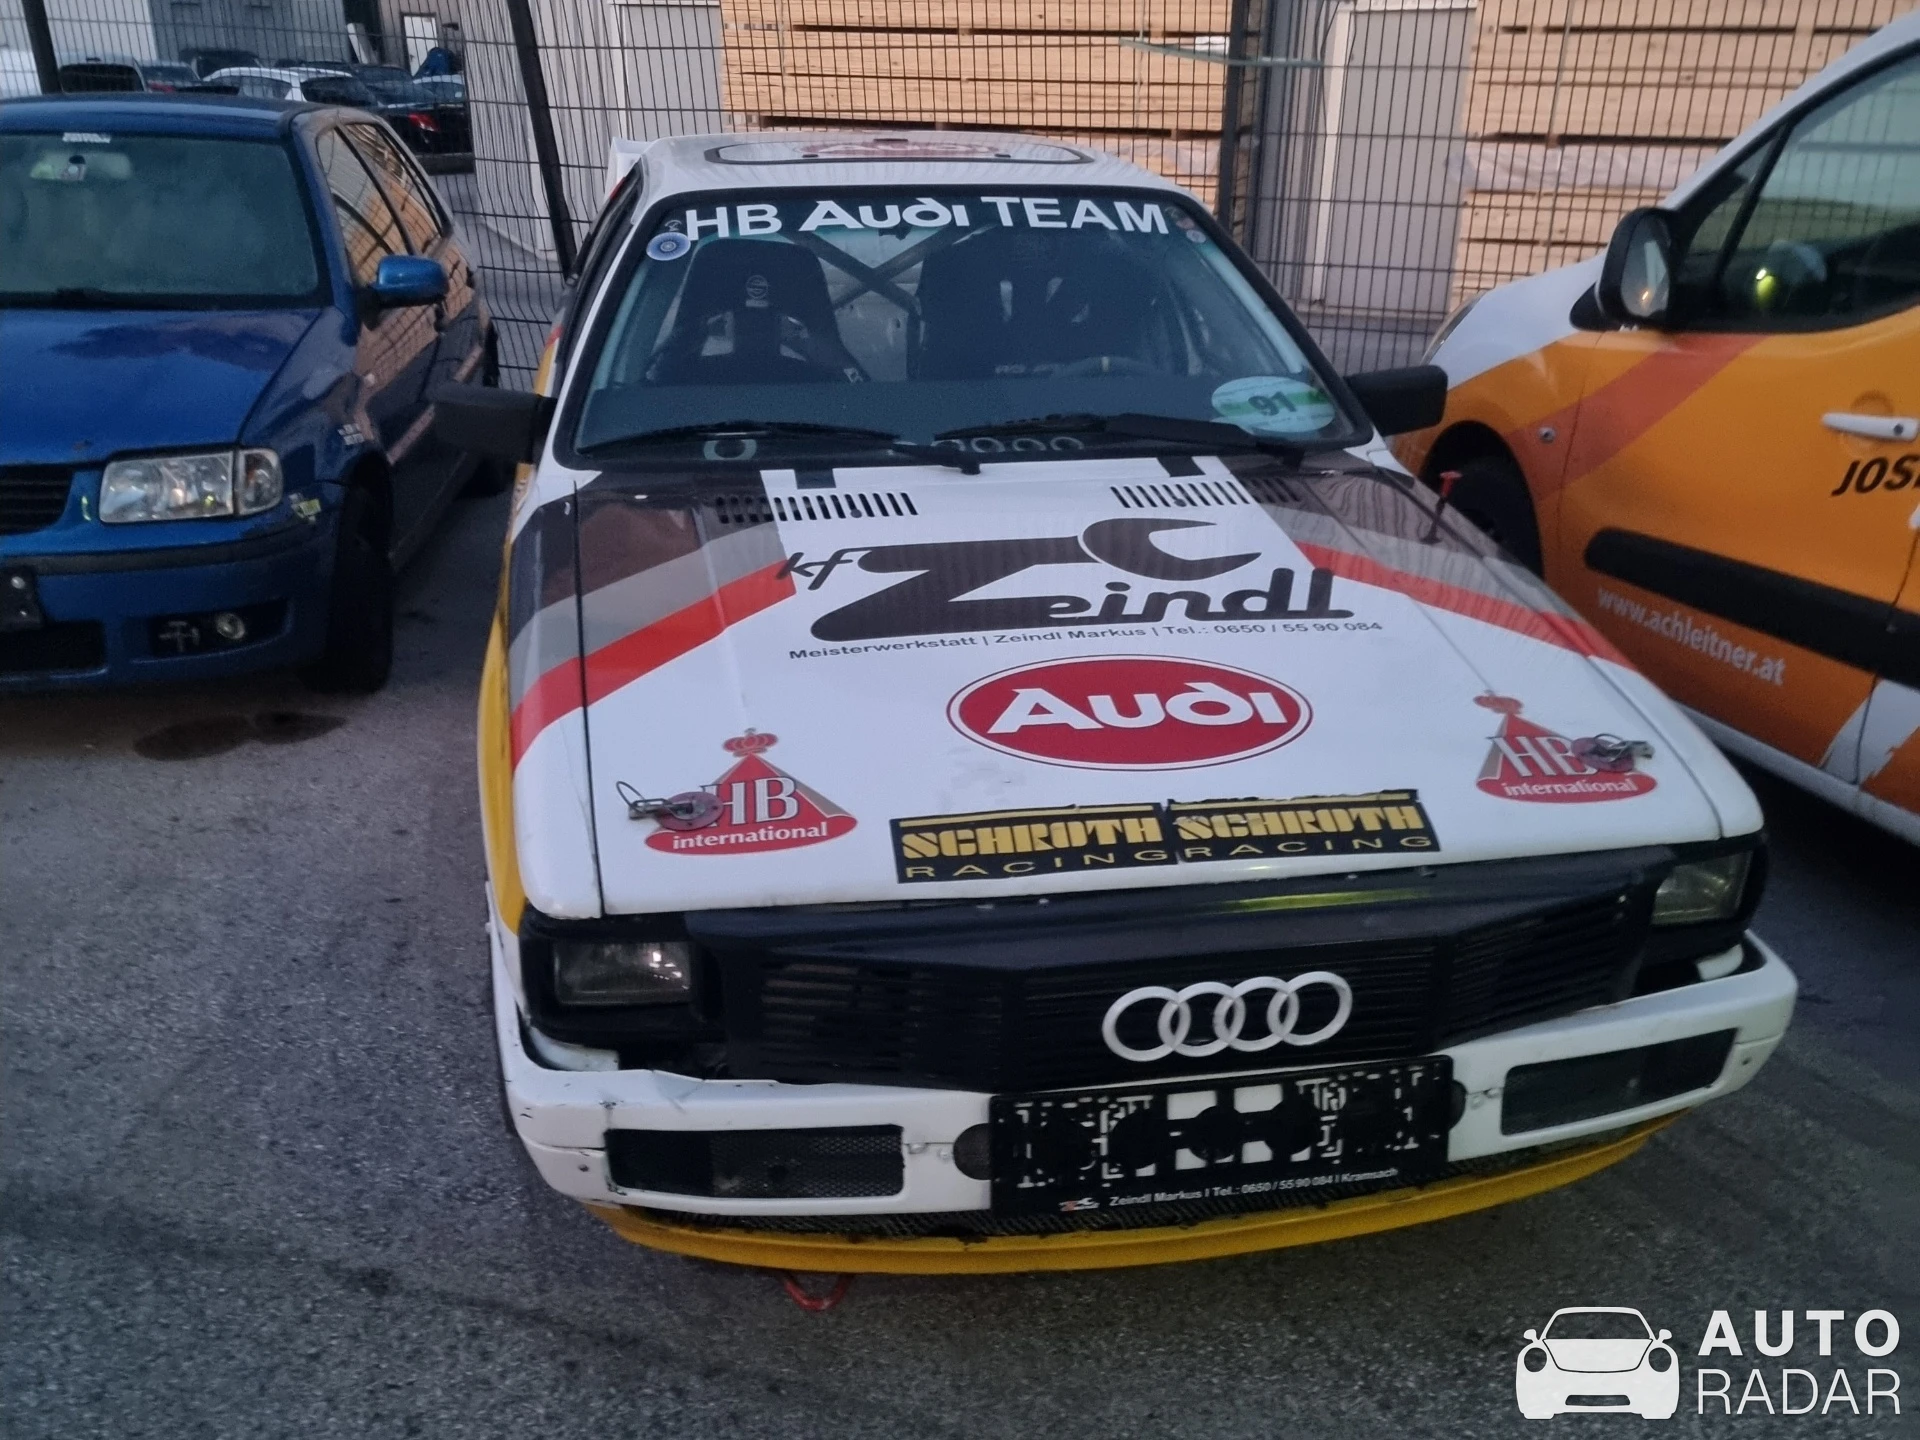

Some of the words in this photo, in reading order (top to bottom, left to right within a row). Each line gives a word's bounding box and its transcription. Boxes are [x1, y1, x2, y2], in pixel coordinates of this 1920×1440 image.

[686, 204, 782, 241] HB
[799, 198, 969, 231] Audi
[981, 197, 1169, 234] TEAM
[1831, 453, 1920, 497] JOS
[789, 636, 978, 659] Meisterwerkstatt
[995, 631, 1063, 645] Zeindl
[1069, 627, 1147, 640] Markus
[1166, 625, 1207, 635] Tel.:
[1214, 624, 1266, 634] 0650
[1281, 622, 1309, 633] 55
[1314, 622, 1341, 632] 90
[1346, 621, 1384, 632] 084
[1597, 588, 1786, 686] www.achleitner.at
[987, 682, 1287, 734] Audi
[1501, 778, 1639, 797] international
[672, 821, 828, 850] international
[901, 817, 1164, 859] SCHROTH
[1173, 805, 1425, 841] SCHROTH
[905, 849, 1169, 879] RACING
[1184, 836, 1432, 859] RACING
[1154, 1186, 1203, 1202] Markus
